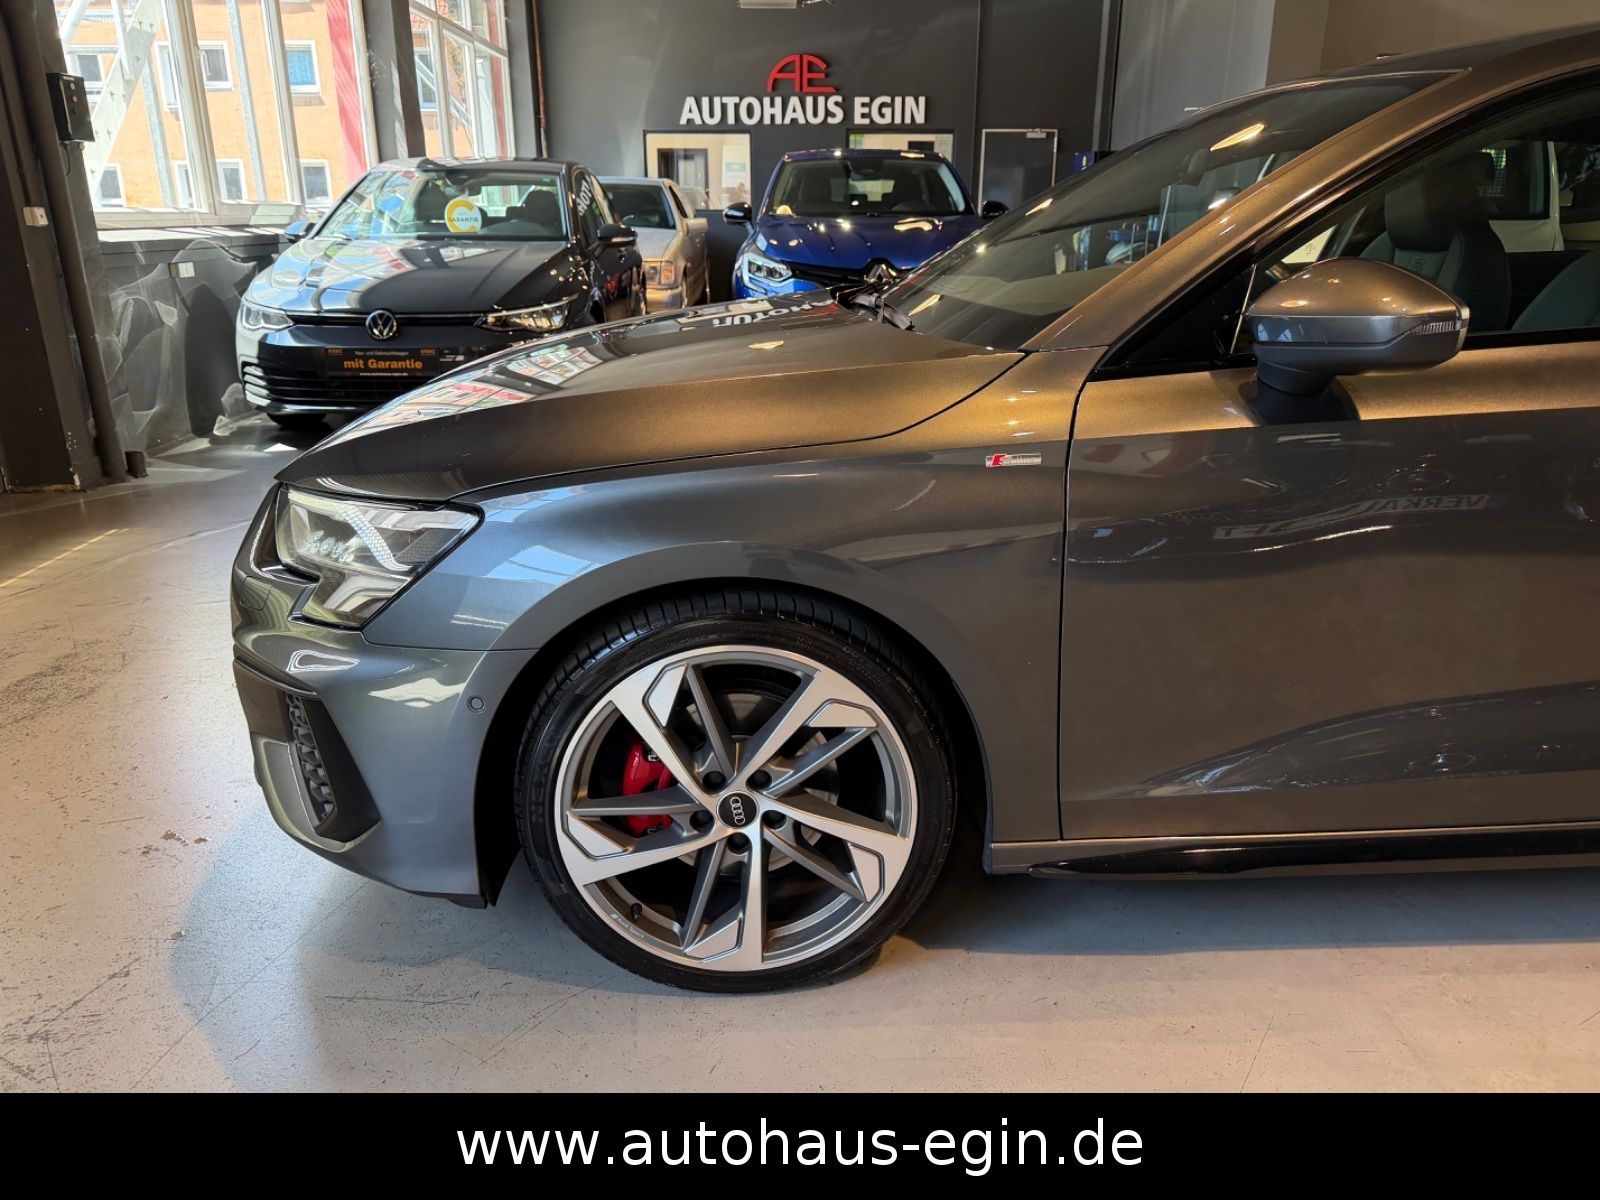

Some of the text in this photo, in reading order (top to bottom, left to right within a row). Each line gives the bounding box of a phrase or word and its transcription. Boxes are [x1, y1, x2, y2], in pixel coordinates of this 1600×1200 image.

[680, 95, 926, 125] AUTOHAUS EGIN
[343, 358, 423, 369] mit Garantie
